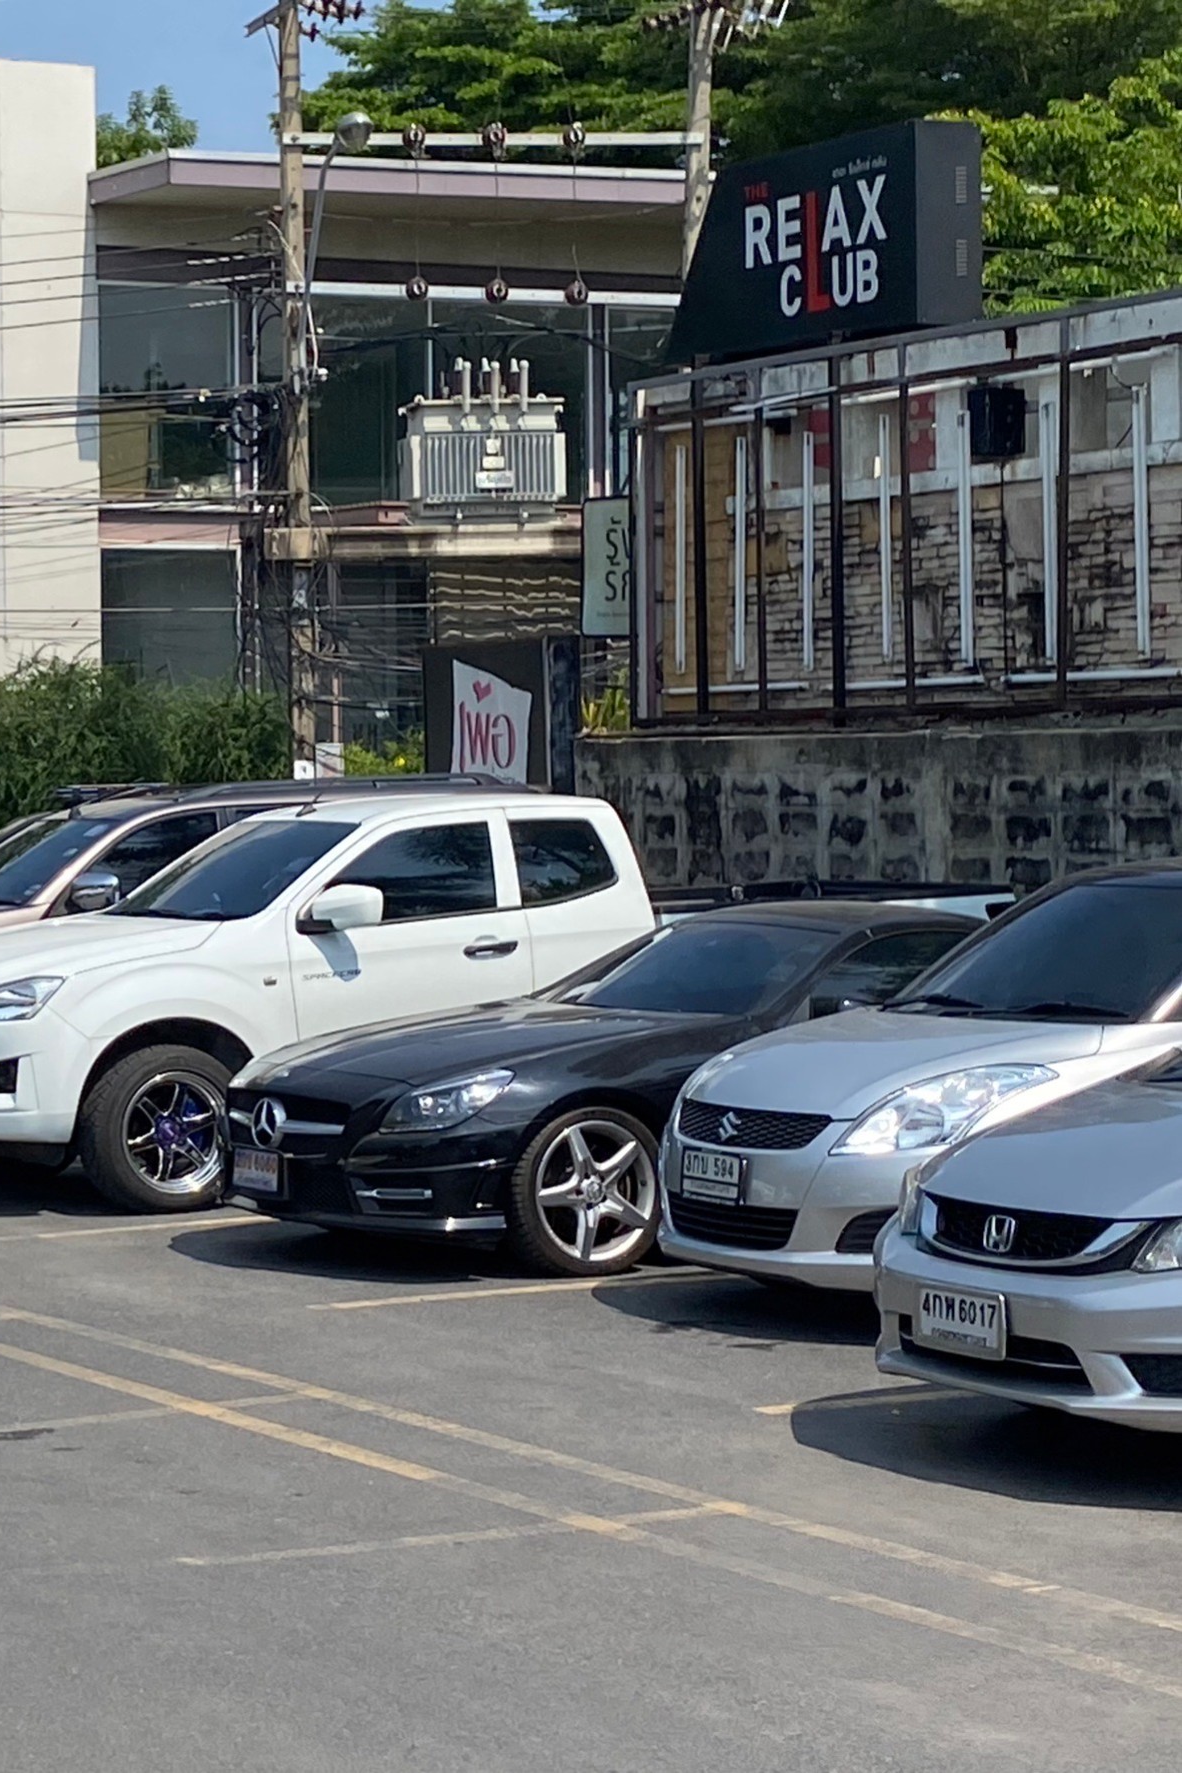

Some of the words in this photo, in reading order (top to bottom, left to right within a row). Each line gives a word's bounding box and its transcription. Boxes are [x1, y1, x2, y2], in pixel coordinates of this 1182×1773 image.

[744, 181, 769, 199] THE
[744, 174, 888, 269] RELAX
[779, 249, 880, 318] CLUB
[714, 1157, 734, 1179] 594
[959, 1298, 996, 1329] 6017
